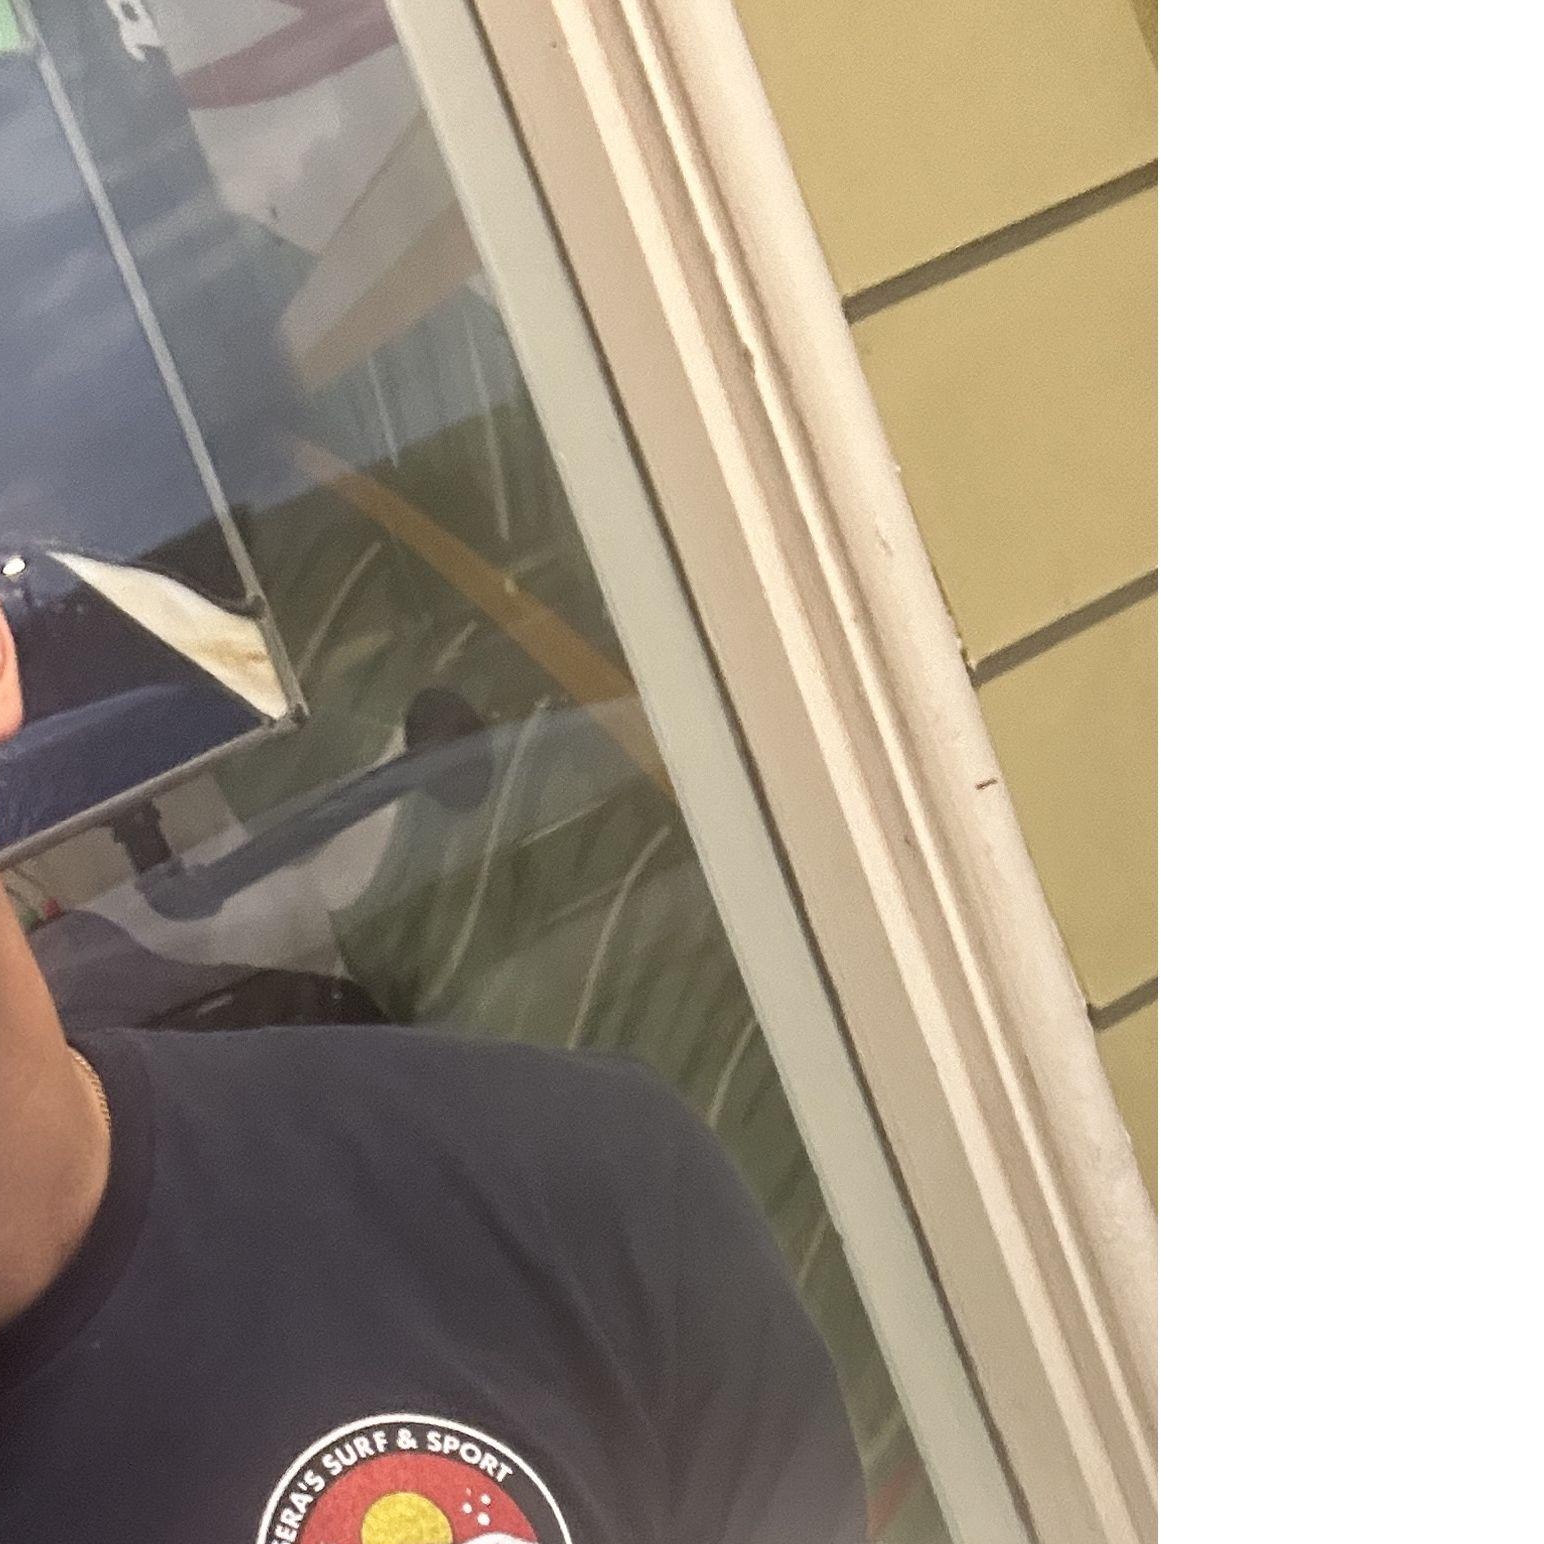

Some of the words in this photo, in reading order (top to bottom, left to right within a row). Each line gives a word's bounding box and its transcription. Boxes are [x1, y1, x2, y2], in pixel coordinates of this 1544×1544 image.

[321, 1431, 390, 1476] SURF
[395, 1427, 418, 1450] &
[426, 1430, 514, 1483] SPORT
